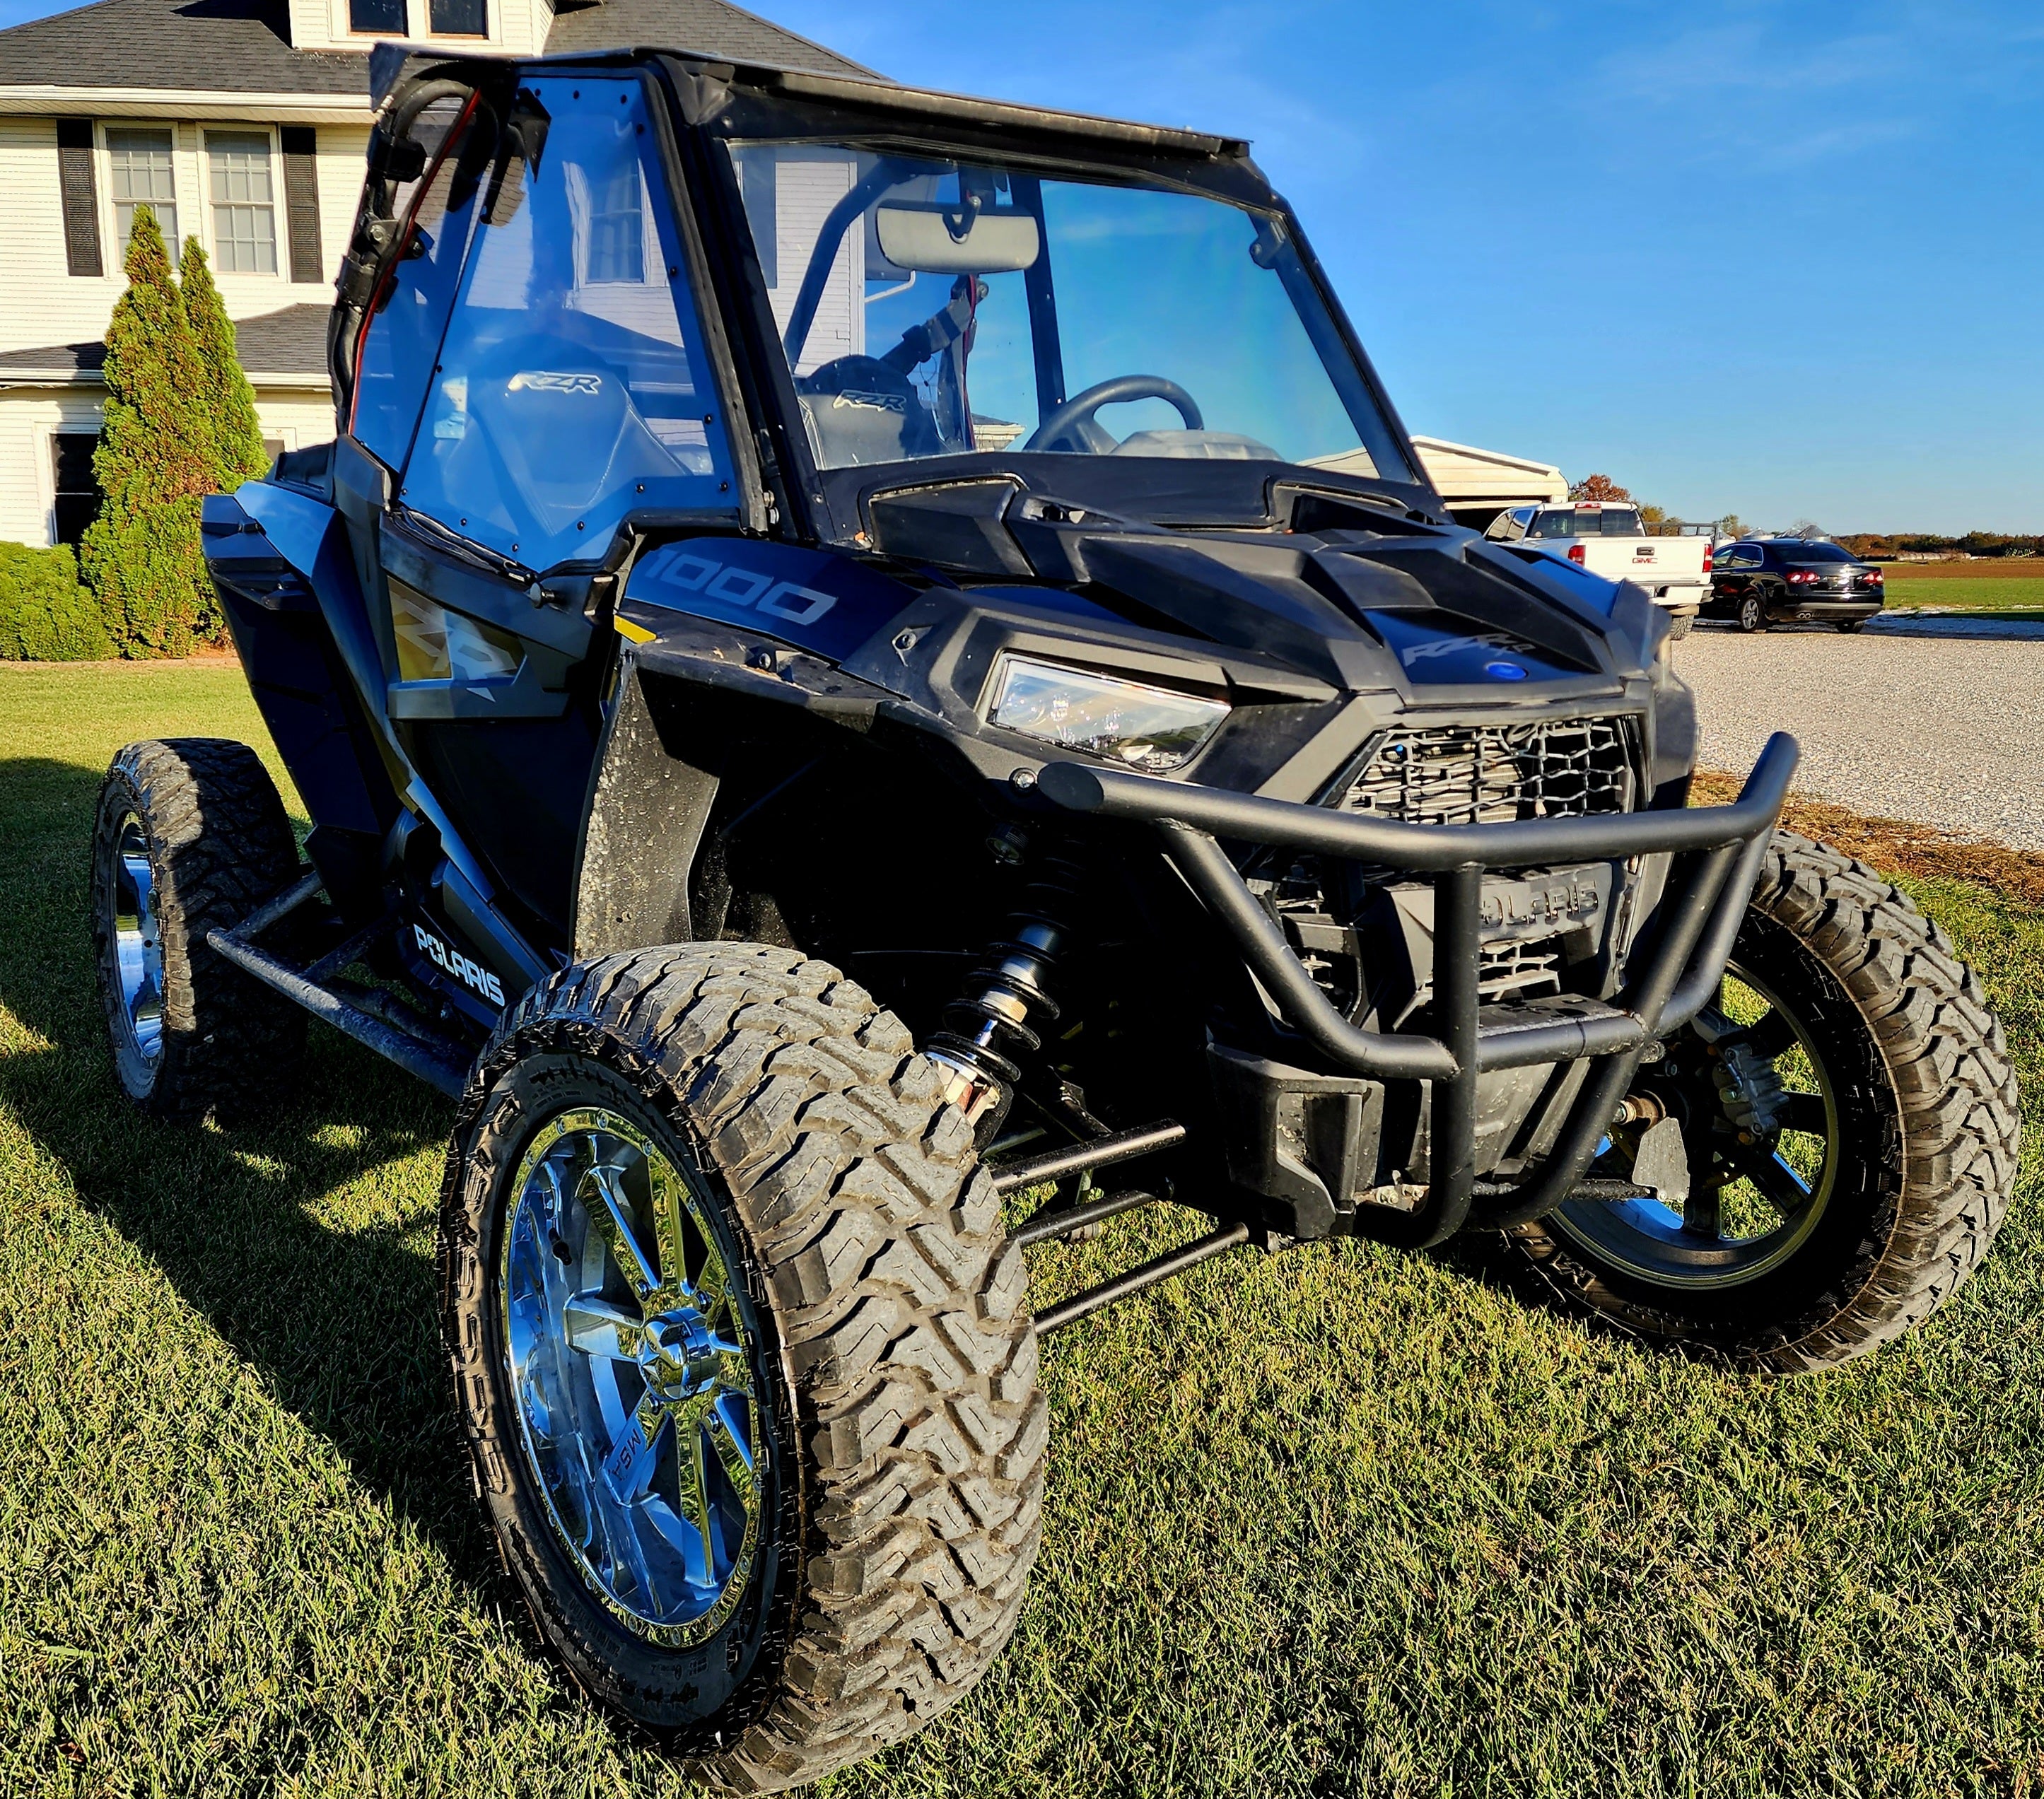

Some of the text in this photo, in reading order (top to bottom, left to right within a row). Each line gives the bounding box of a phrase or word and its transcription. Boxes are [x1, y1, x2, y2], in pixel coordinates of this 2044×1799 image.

[507, 370, 602, 395] RZR
[833, 389, 906, 412] RZR
[645, 549, 839, 626] 1000
[1481, 880, 1600, 930] OLARIS
[413, 923, 506, 1007] POLARIS
